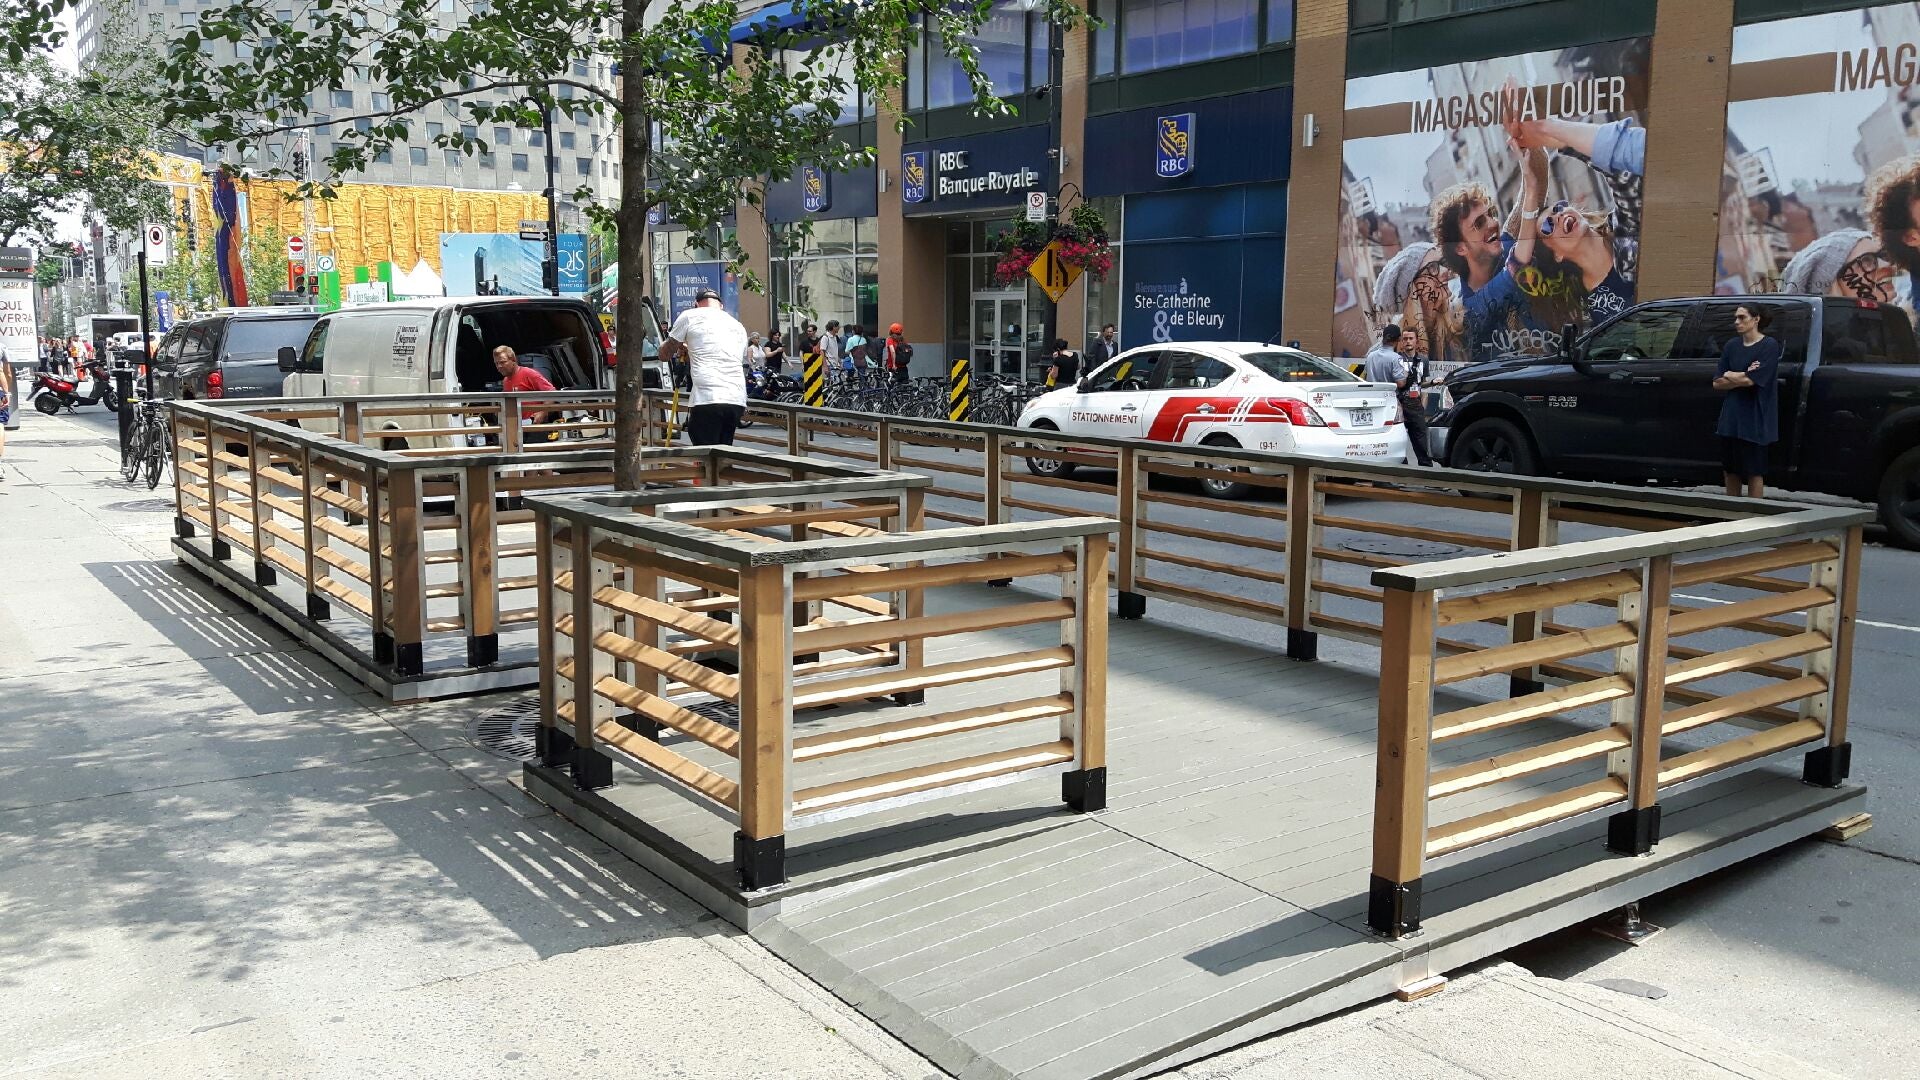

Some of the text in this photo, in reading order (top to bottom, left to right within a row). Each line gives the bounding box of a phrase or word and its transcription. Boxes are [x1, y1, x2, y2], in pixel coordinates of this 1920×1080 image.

[1839, 42, 1920, 93] MAG
[1413, 90, 1514, 133] MAGASIN
[1546, 76, 1626, 121] LOUER
[940, 151, 967, 172] RBC
[1160, 157, 1185, 173] RBC
[940, 167, 1036, 198] Banque Royale
[906, 187, 923, 198] RBC
[806, 196, 820, 208] RBC
[1135, 277, 1188, 294] Bienvenue à
[1135, 293, 1211, 309] Ste-Catherine
[1152, 310, 1225, 342] & de Bleury
[1072, 411, 1138, 424] STATIONNEMENT
